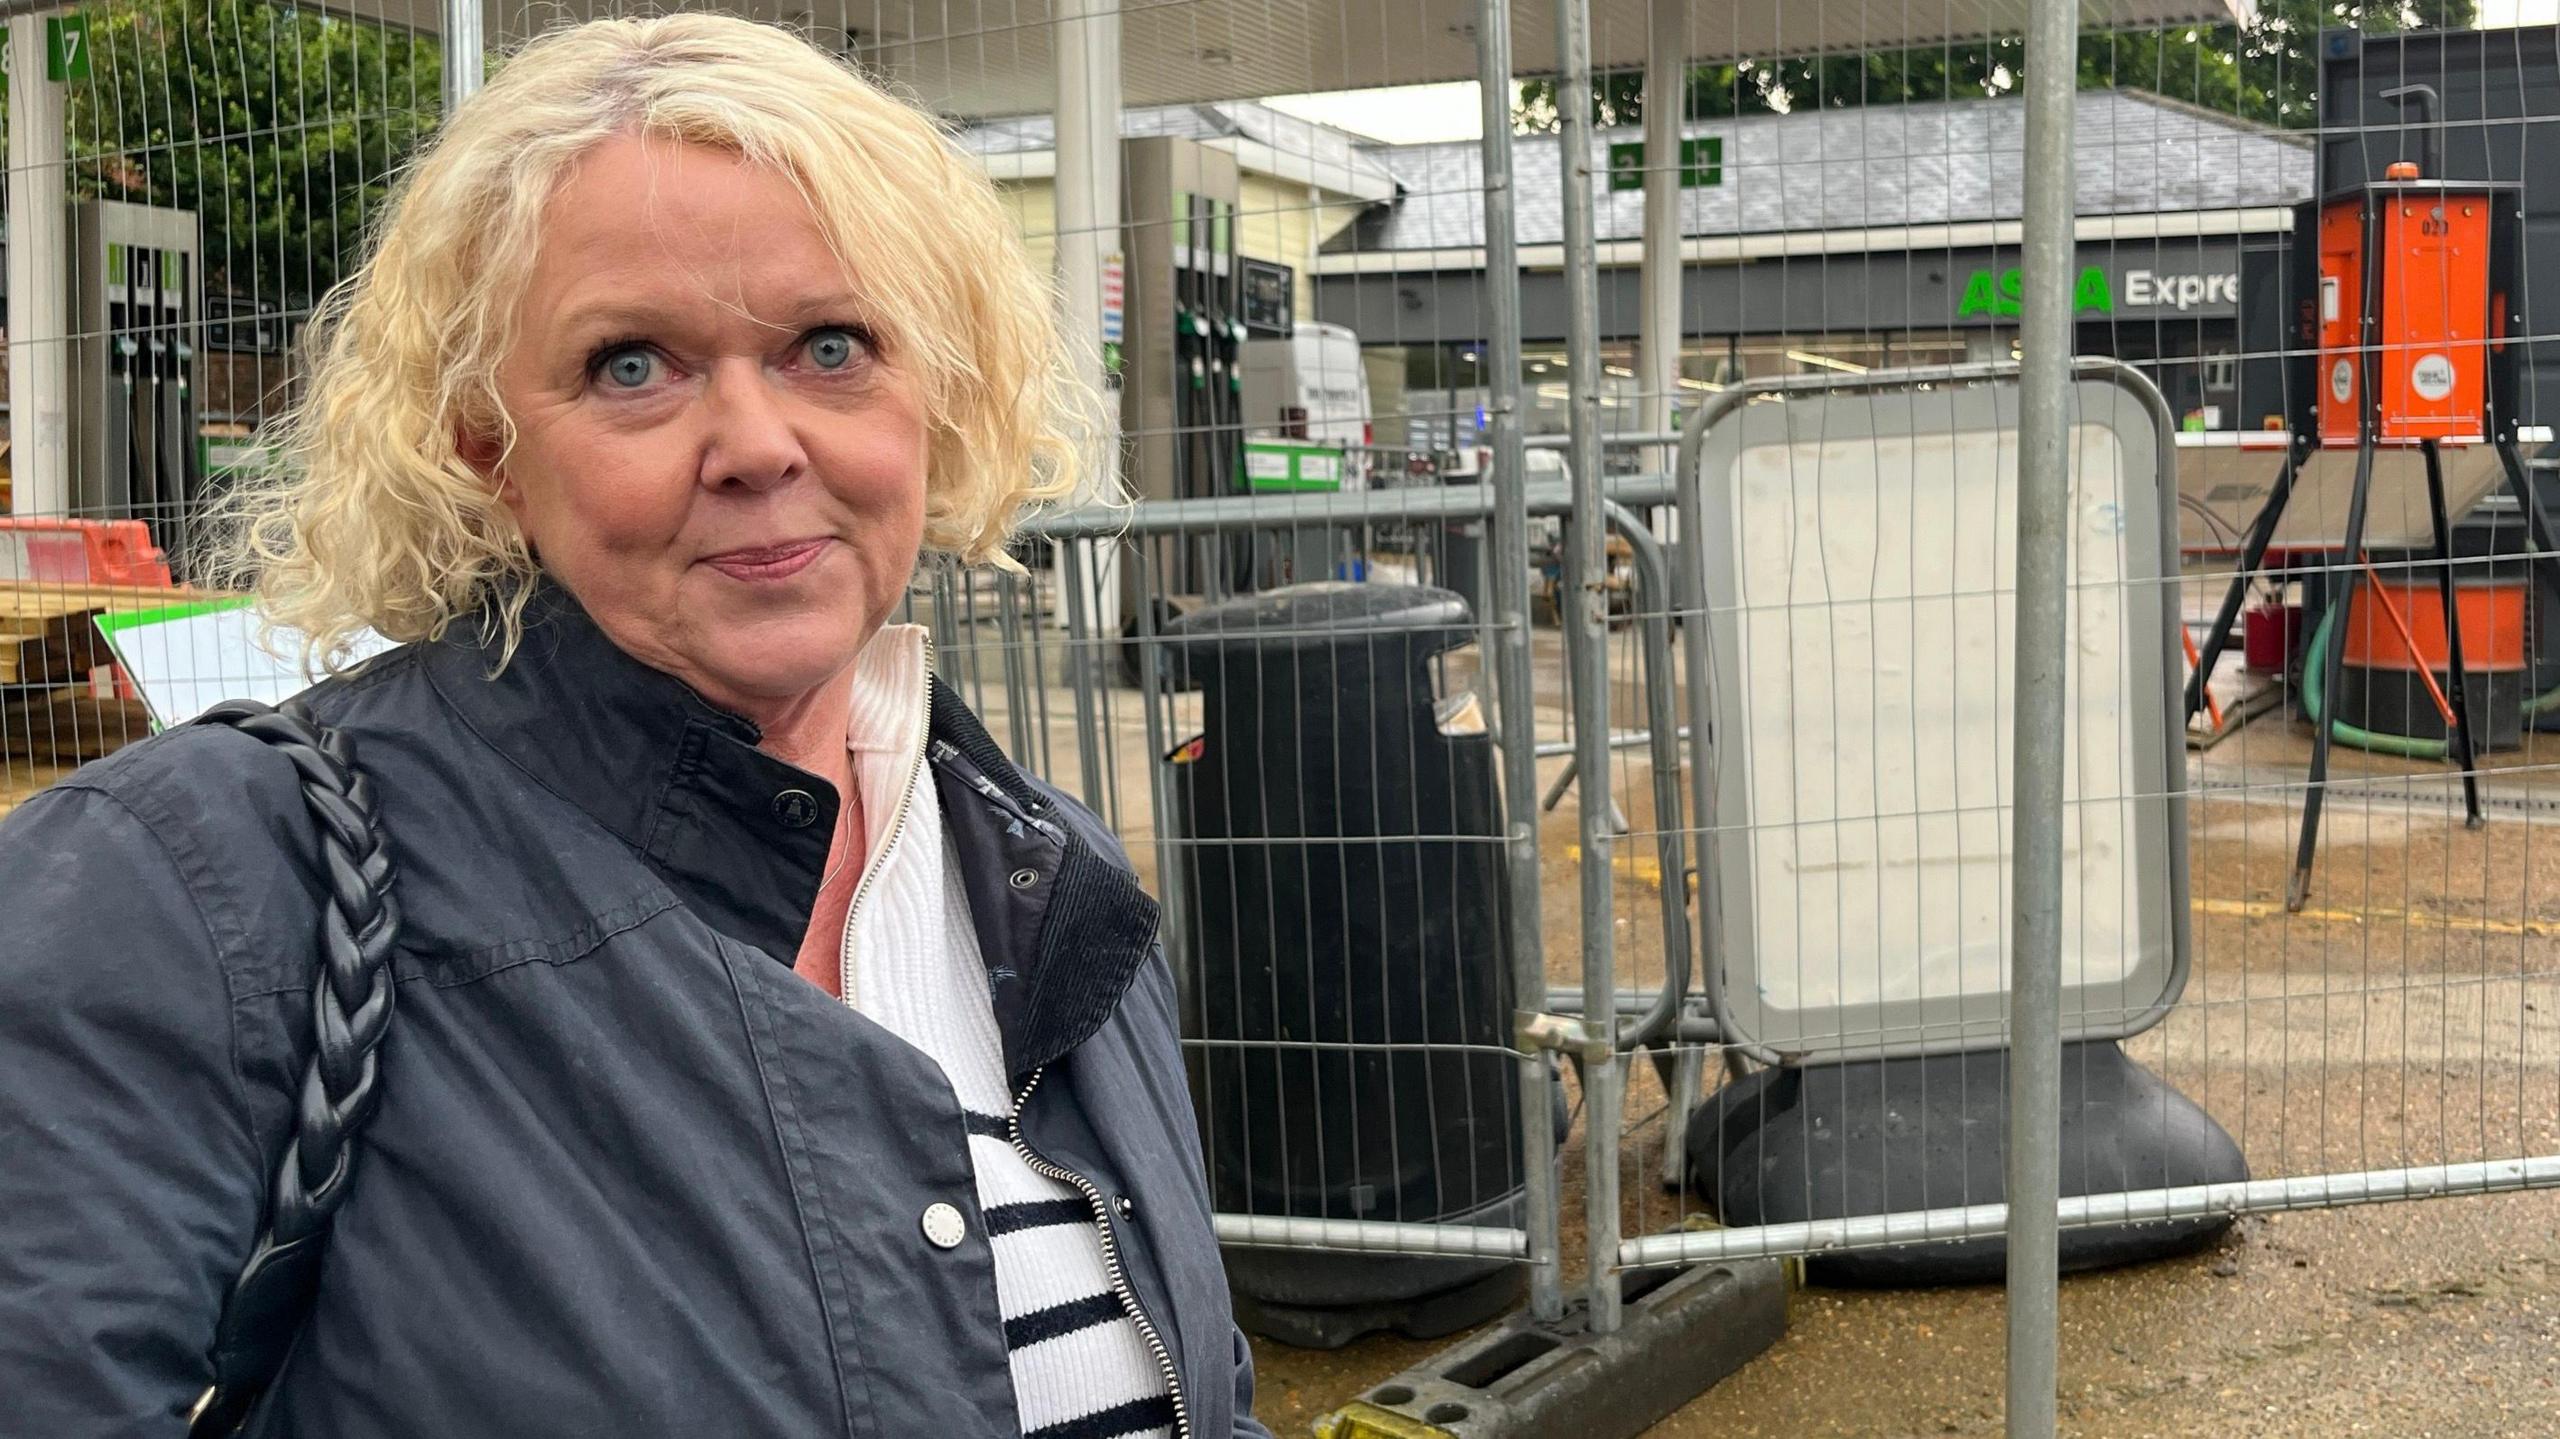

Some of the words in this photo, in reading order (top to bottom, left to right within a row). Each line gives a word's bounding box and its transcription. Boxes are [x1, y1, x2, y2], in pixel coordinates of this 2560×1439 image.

[65, 31, 80, 67] 7
[1617, 154, 1636, 181] 2
[1957, 265, 2114, 319] ASA
